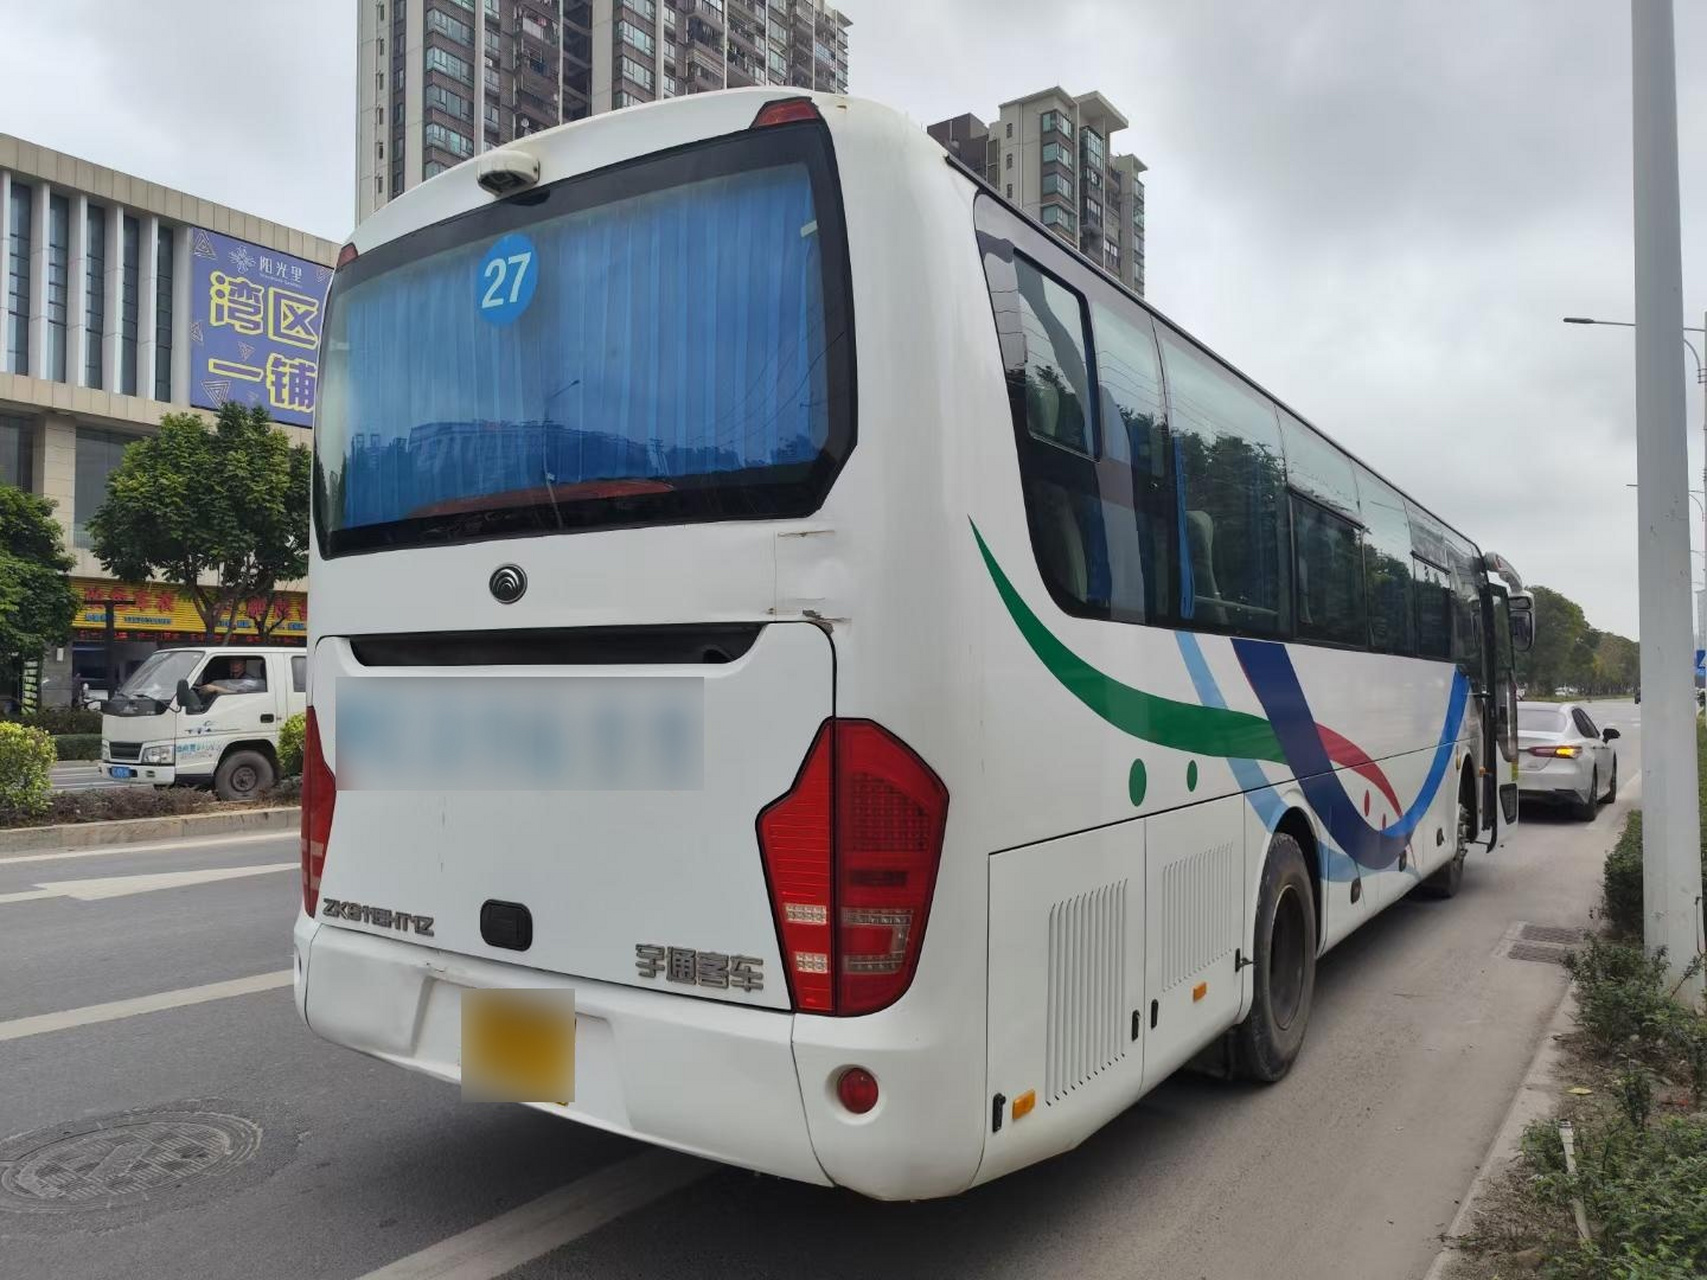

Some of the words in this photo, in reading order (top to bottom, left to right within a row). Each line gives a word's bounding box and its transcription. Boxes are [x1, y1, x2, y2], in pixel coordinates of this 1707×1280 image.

[259, 255, 303, 284] 阳光里
[481, 251, 532, 309] 27
[209, 270, 320, 350] 湾区
[635, 943, 764, 992] 宇通客车
